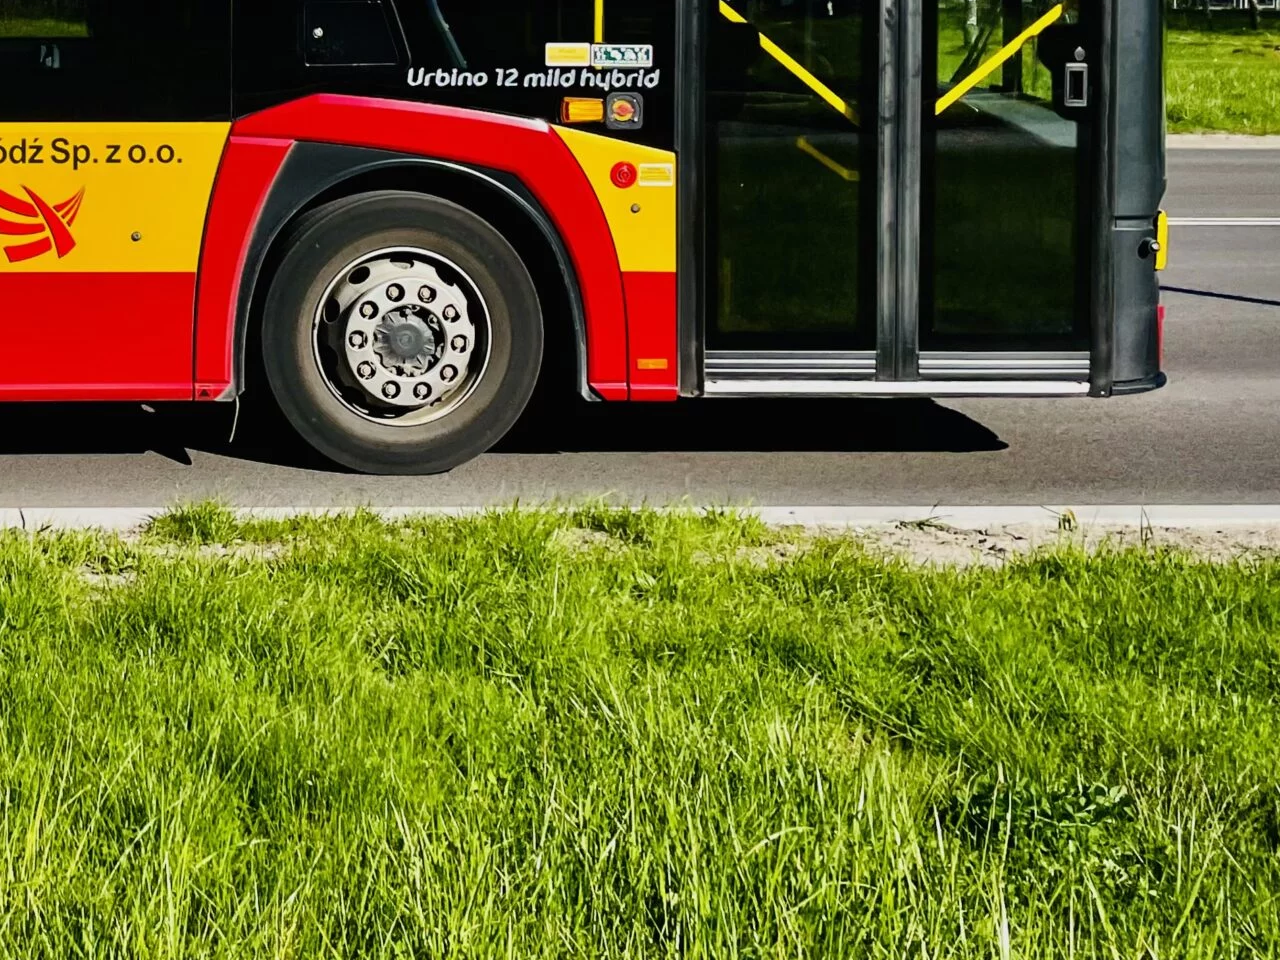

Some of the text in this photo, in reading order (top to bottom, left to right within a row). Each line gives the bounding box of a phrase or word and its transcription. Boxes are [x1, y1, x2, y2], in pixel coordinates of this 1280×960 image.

[407, 67, 661, 91] Urbino 12 mild hybrid
[50, 137, 99, 171] Sp.
[104, 144, 122, 164] z
[127, 144, 183, 165] o.o.
